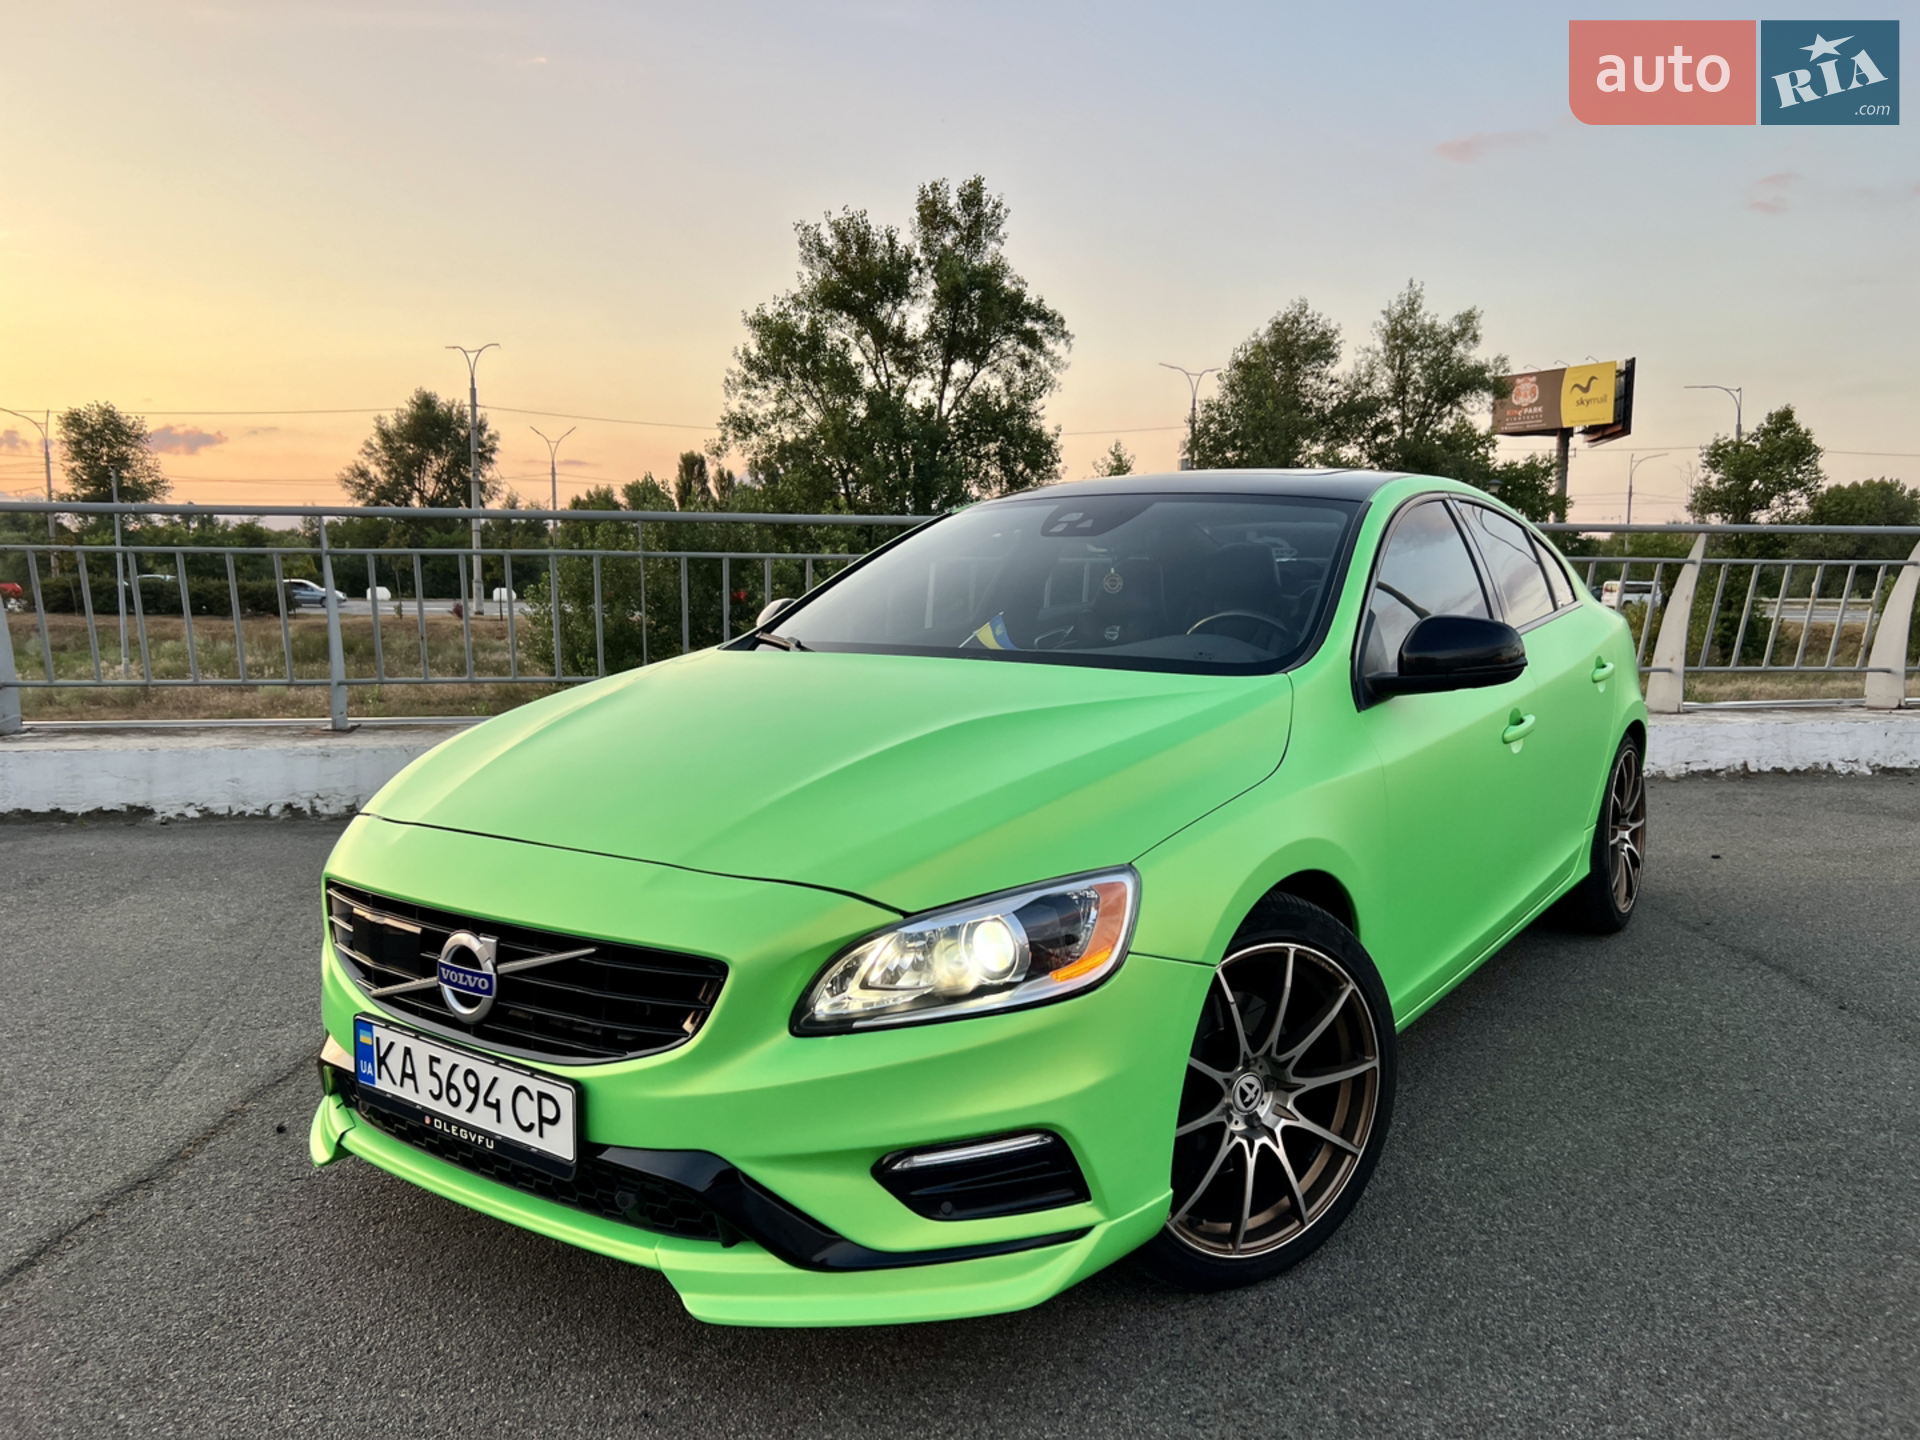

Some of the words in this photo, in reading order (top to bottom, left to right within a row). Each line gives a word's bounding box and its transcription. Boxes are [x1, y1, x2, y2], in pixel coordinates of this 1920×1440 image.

[440, 966, 490, 990] VOLVO
[359, 1059, 374, 1077] UA
[375, 1035, 420, 1095] KA
[428, 1053, 502, 1125] 5694
[511, 1084, 562, 1139] CP
